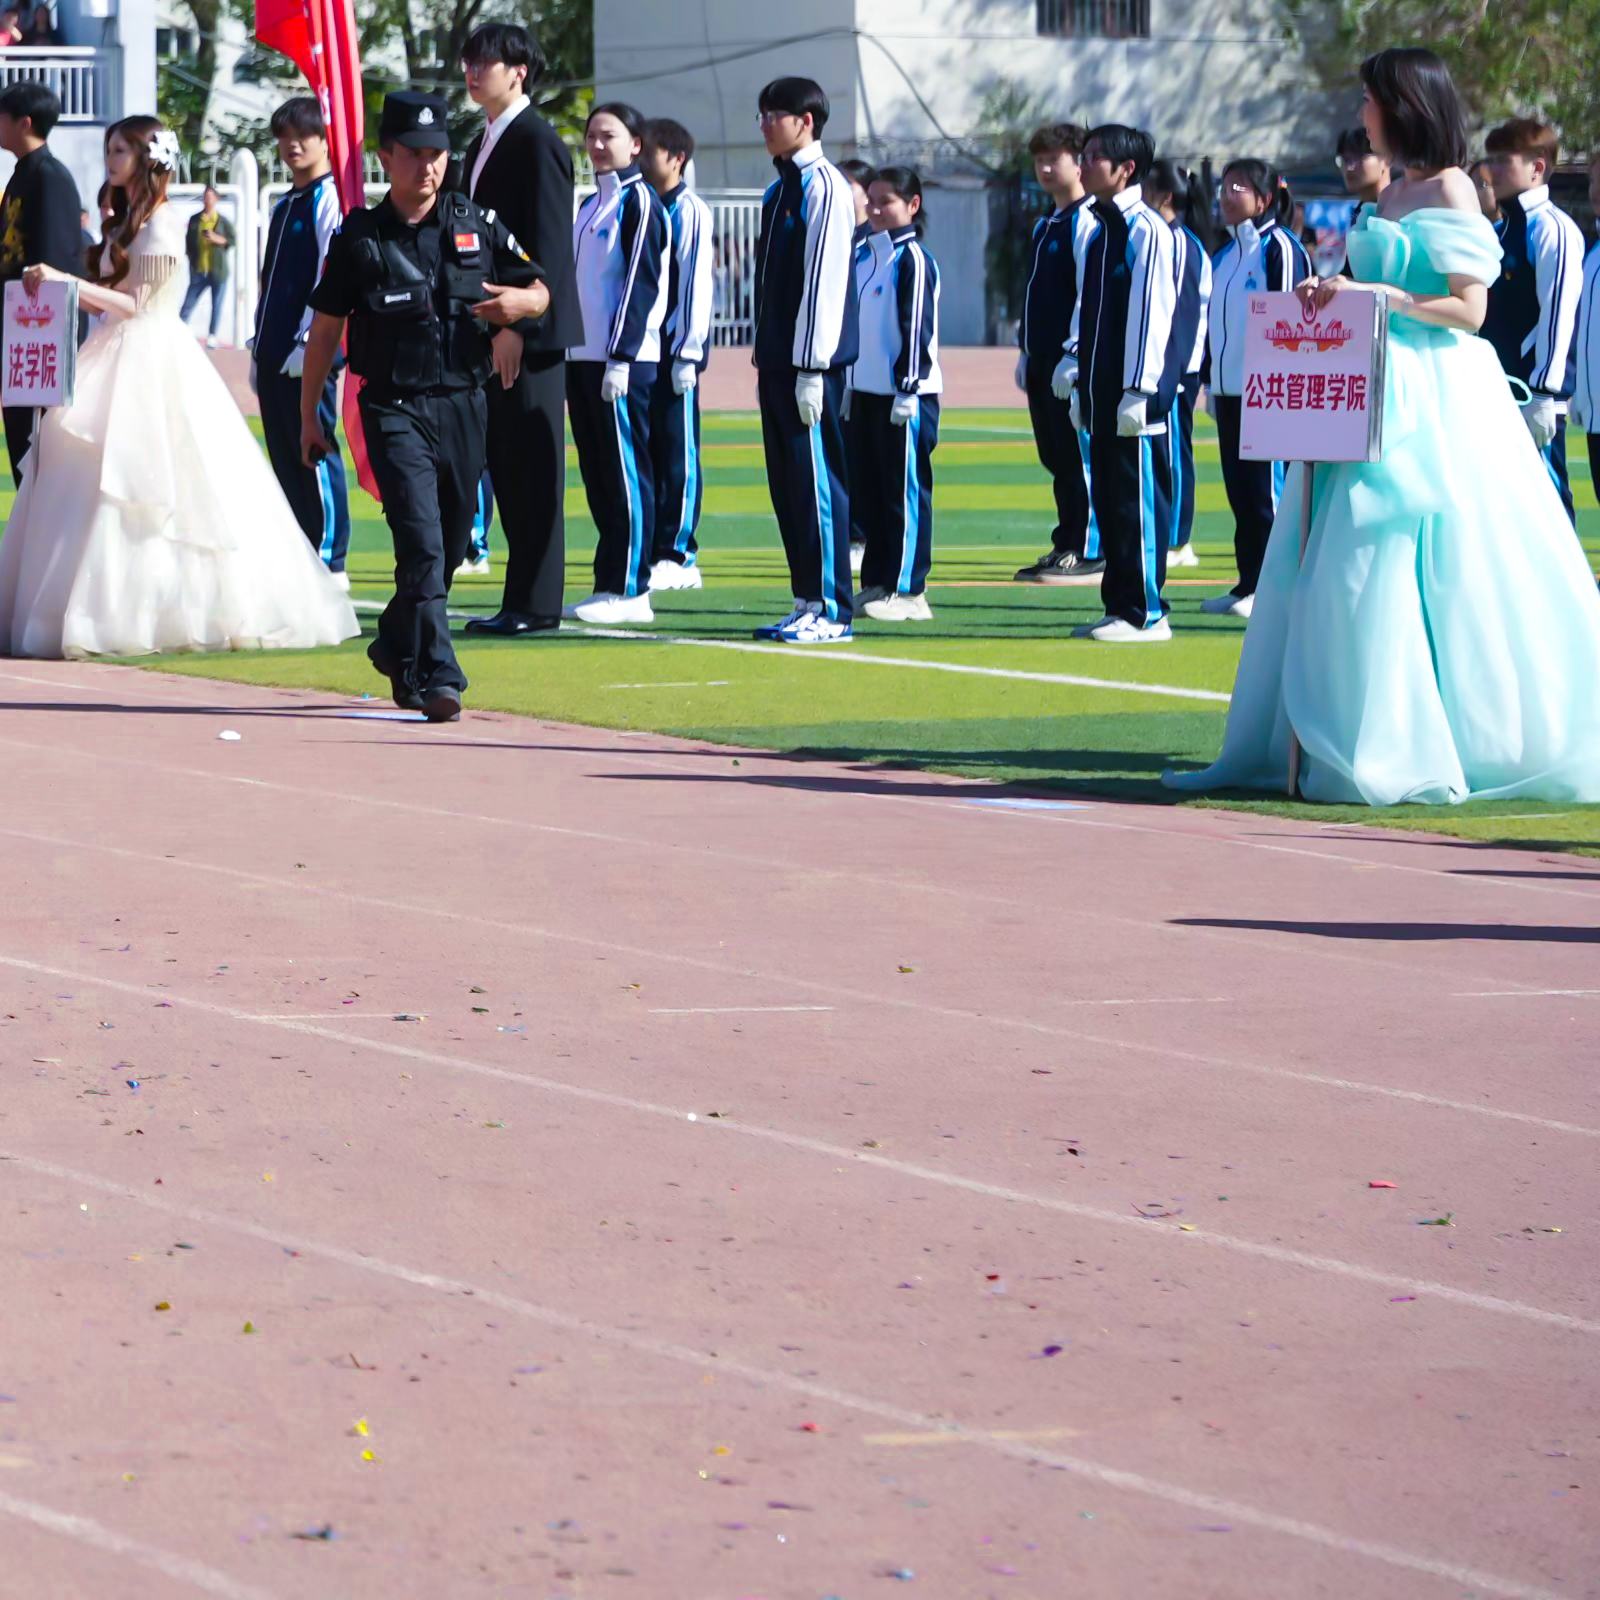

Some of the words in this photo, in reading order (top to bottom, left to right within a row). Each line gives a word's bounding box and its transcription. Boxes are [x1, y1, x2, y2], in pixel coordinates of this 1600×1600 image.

[8, 342, 57, 389] 法学院
[1245, 373, 1367, 411] 公共管理学院
